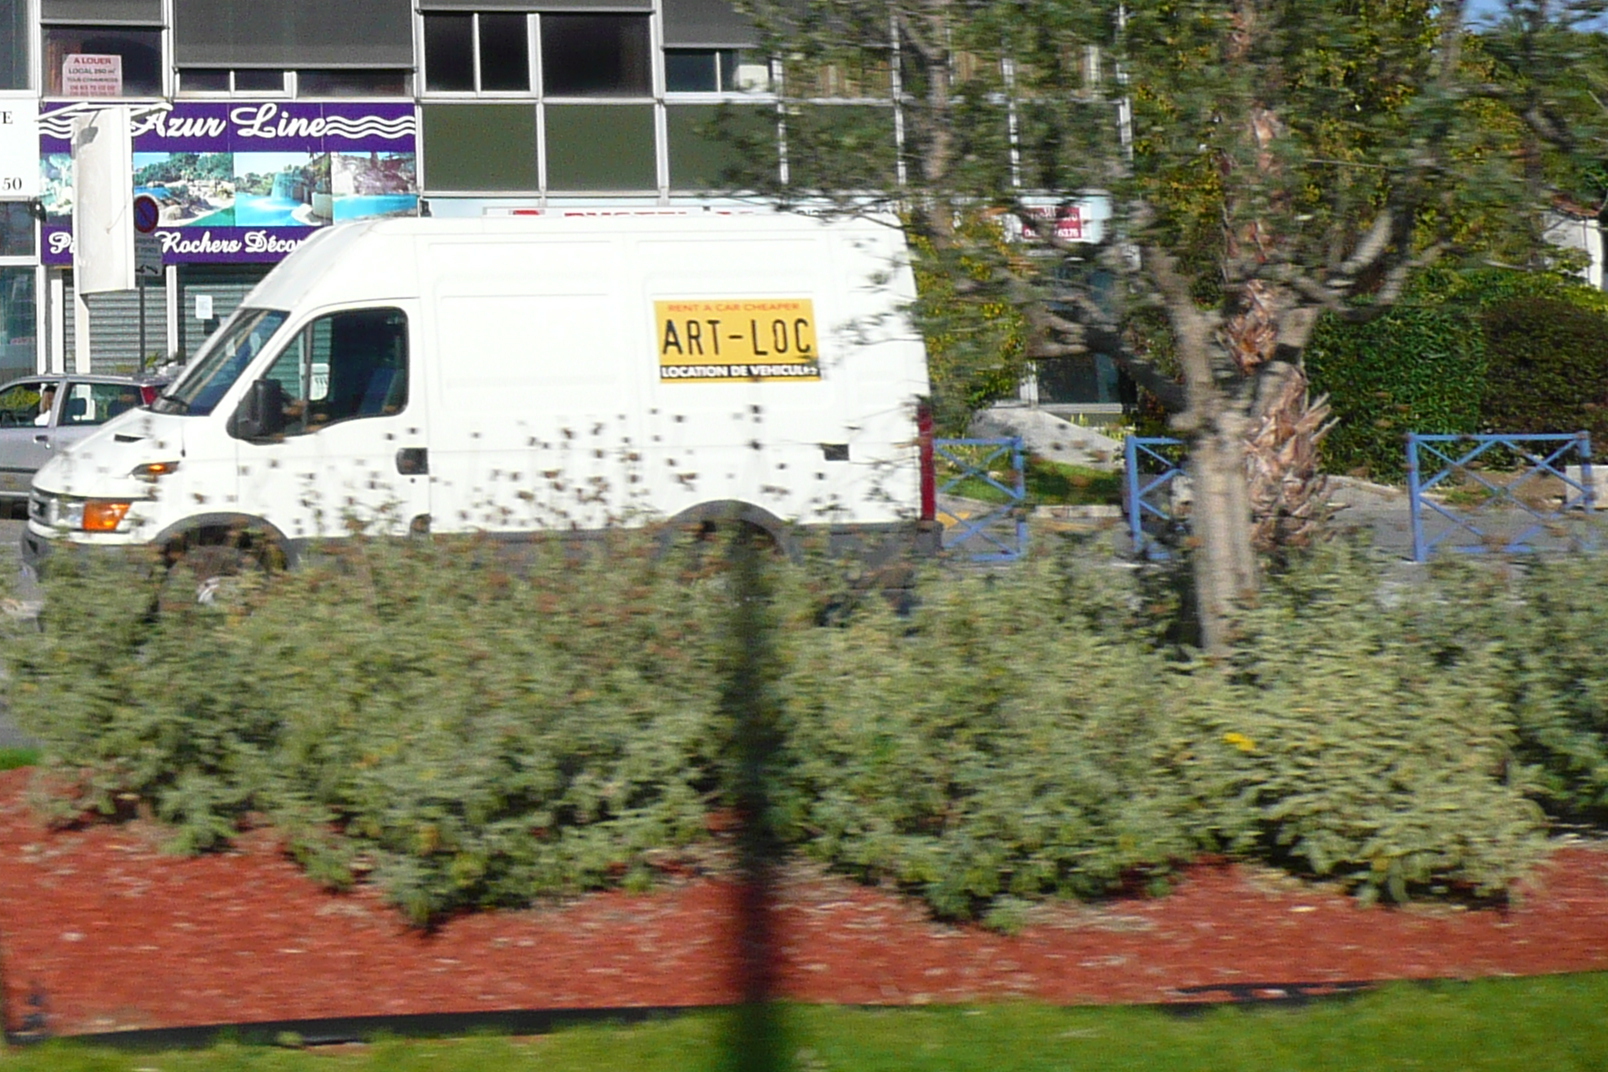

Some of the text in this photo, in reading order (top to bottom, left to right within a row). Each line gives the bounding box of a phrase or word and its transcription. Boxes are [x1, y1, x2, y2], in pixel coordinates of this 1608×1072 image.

[132, 103, 328, 138] Azur Line
[2, 177, 23, 191] 50
[154, 231, 241, 254] Rochers
[668, 304, 698, 312] RENT
[744, 303, 800, 311] CHEAPER
[662, 318, 811, 356] ART-LOC
[662, 366, 728, 378] LOCATION
[730, 365, 748, 376] DE
